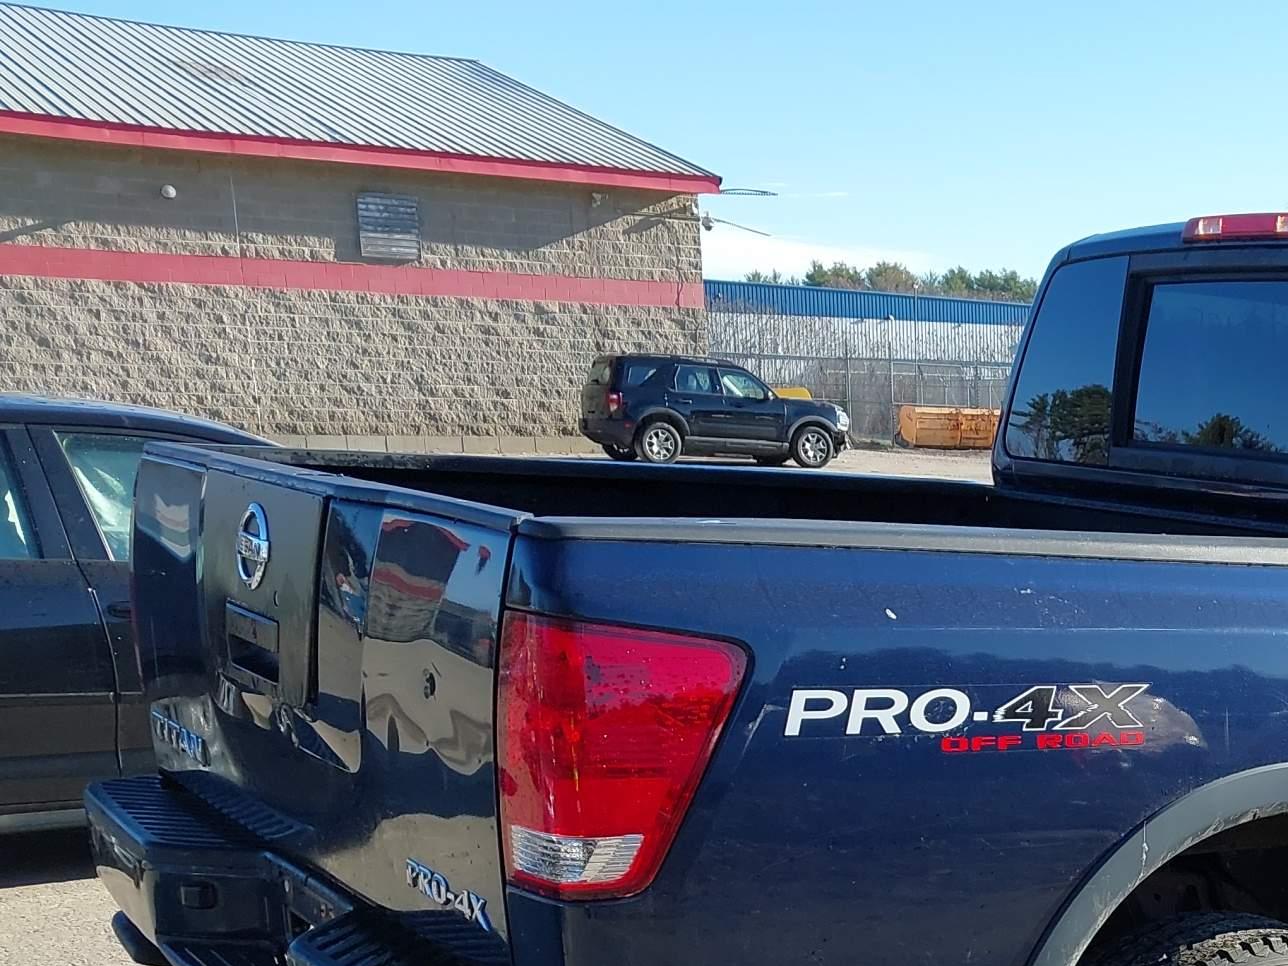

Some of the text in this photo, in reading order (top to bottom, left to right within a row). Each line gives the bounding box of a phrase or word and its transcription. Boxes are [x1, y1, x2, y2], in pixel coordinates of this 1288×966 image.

[151, 710, 208, 766] TITAN
[940, 731, 1145, 753] OFF ROAD
[406, 858, 491, 932] PRO-4X
